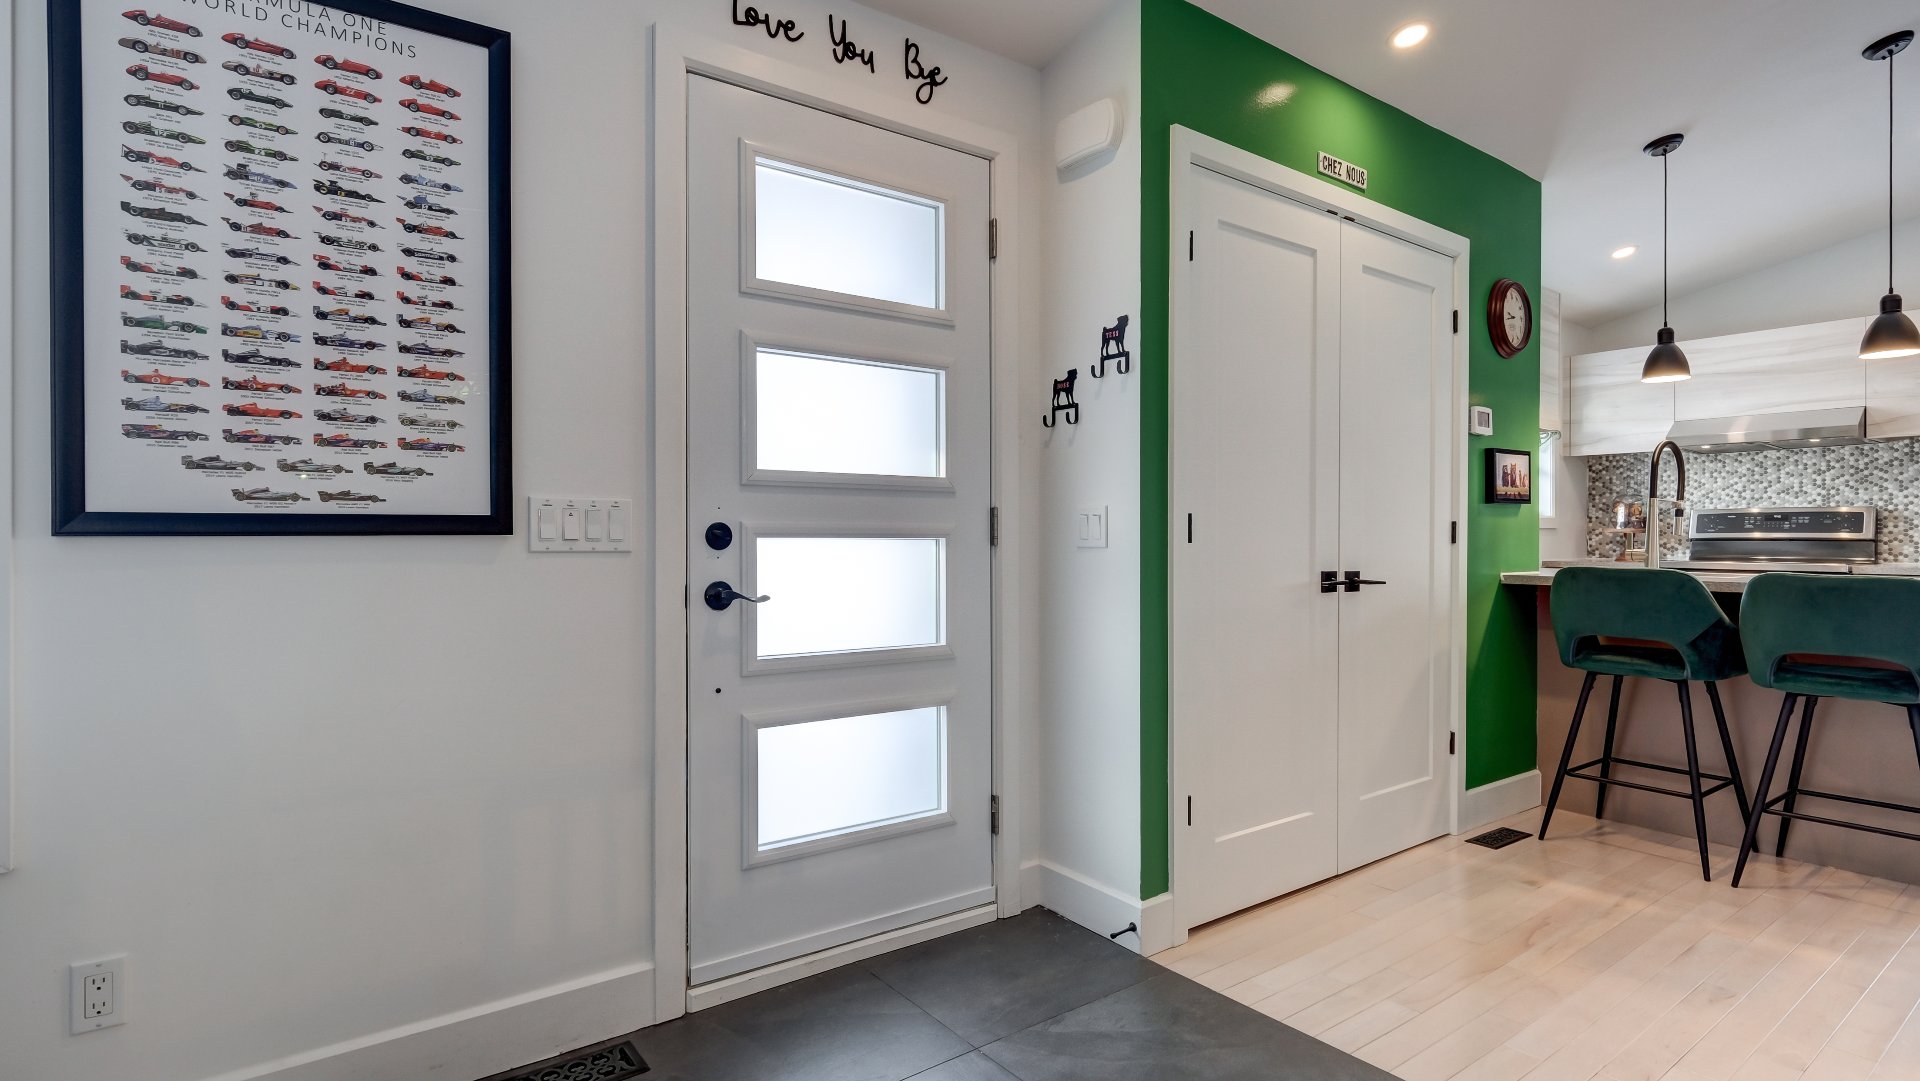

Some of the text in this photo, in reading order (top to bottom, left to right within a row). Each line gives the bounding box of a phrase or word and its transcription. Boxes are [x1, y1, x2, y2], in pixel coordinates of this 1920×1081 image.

[183, 0, 416, 58] ORLD CHAMPIONS
[343, 13, 386, 35] ONE
[732, 0, 948, 104] Love You Bye
[1322, 155, 1365, 185] CHEZ NOUS
